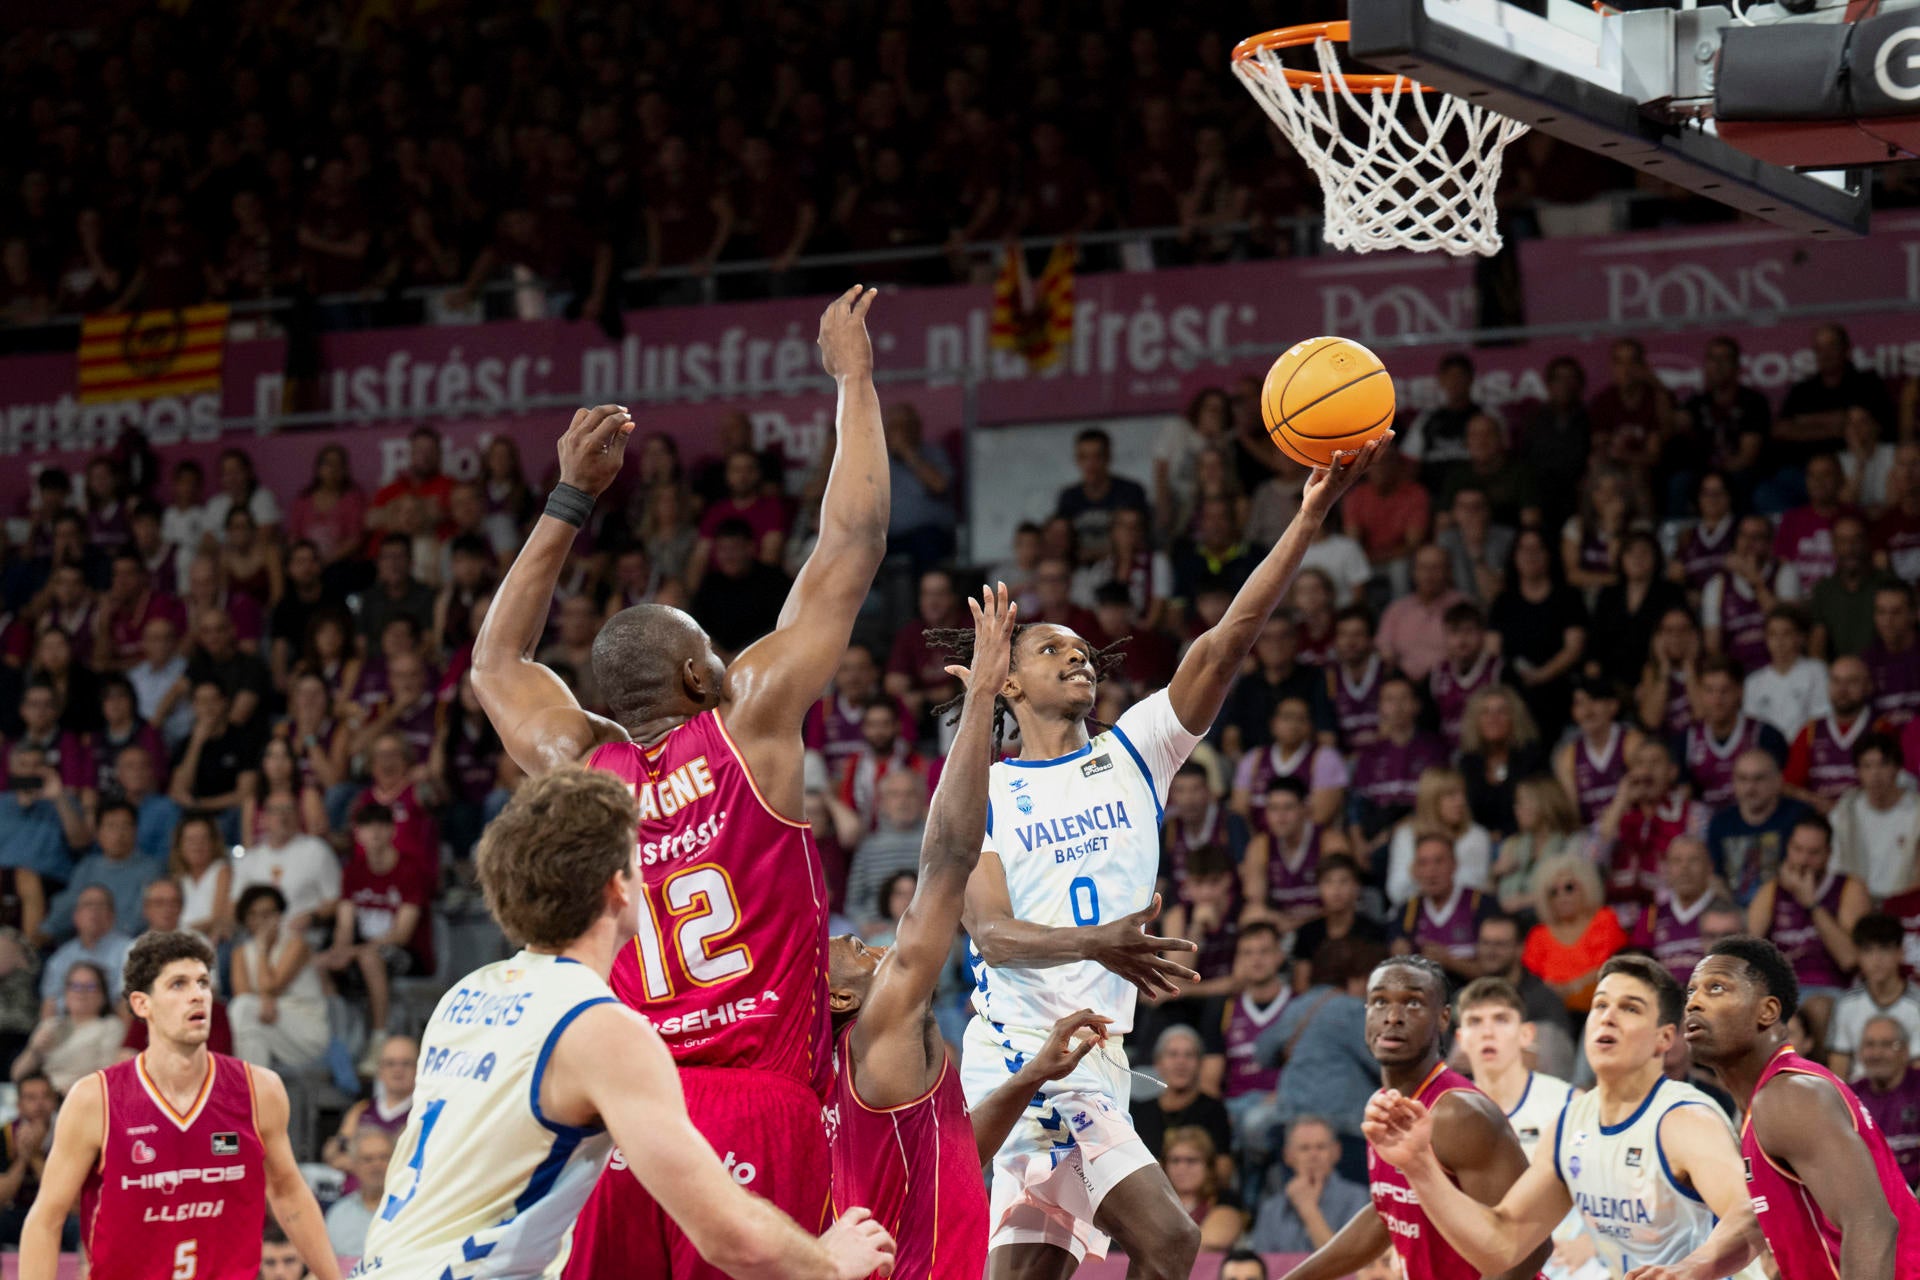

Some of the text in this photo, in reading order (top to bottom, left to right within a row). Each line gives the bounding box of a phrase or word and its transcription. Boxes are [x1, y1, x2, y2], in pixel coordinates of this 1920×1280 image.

[1319, 284, 1477, 346] PON
[1604, 257, 1789, 331] PONS
[0, 390, 223, 455] ritmos
[626, 755, 717, 820] AGNE
[1015, 801, 1132, 852] VALENCIA
[1055, 837, 1110, 864] BASKET
[1069, 876, 1100, 927] 0
[635, 862, 754, 1003] 12
[143, 1199, 225, 1223] LLEIDA
[171, 1238, 198, 1280] 5
